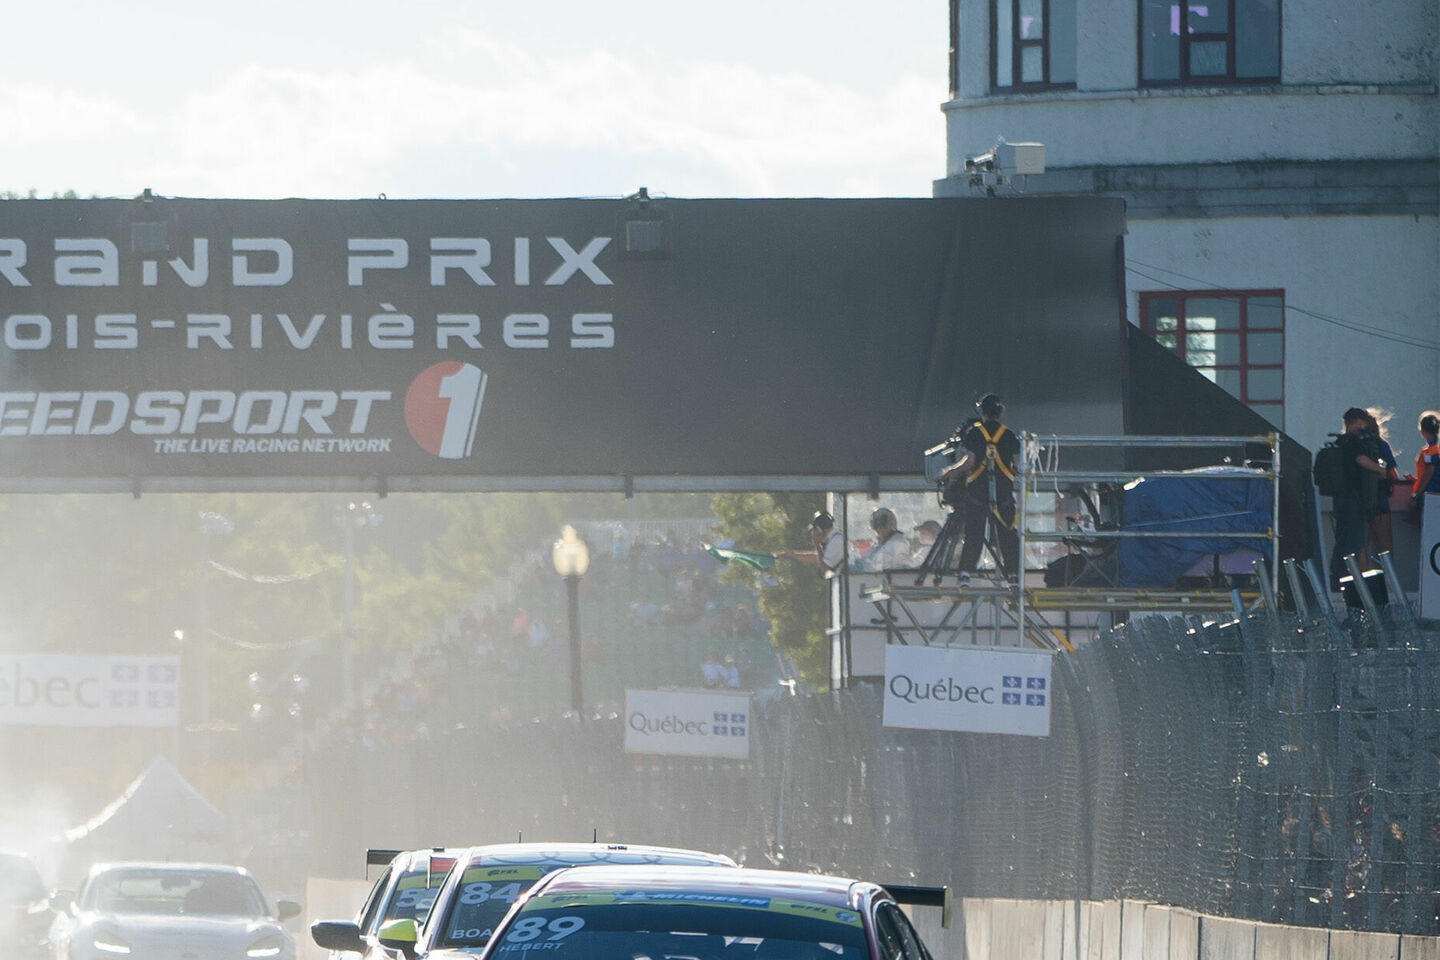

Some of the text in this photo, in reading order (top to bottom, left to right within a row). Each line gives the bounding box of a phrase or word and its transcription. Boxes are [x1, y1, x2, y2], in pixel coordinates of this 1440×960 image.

[348, 237, 615, 286] PRIX
[154, 437, 392, 453] THE LIVE RACING NETWORK
[889, 674, 994, 705] Québec
[629, 711, 708, 738] Québec
[461, 882, 522, 905] 84
[451, 928, 494, 940] BOA
[506, 916, 586, 942] 89
[499, 942, 565, 953] HEBERT
